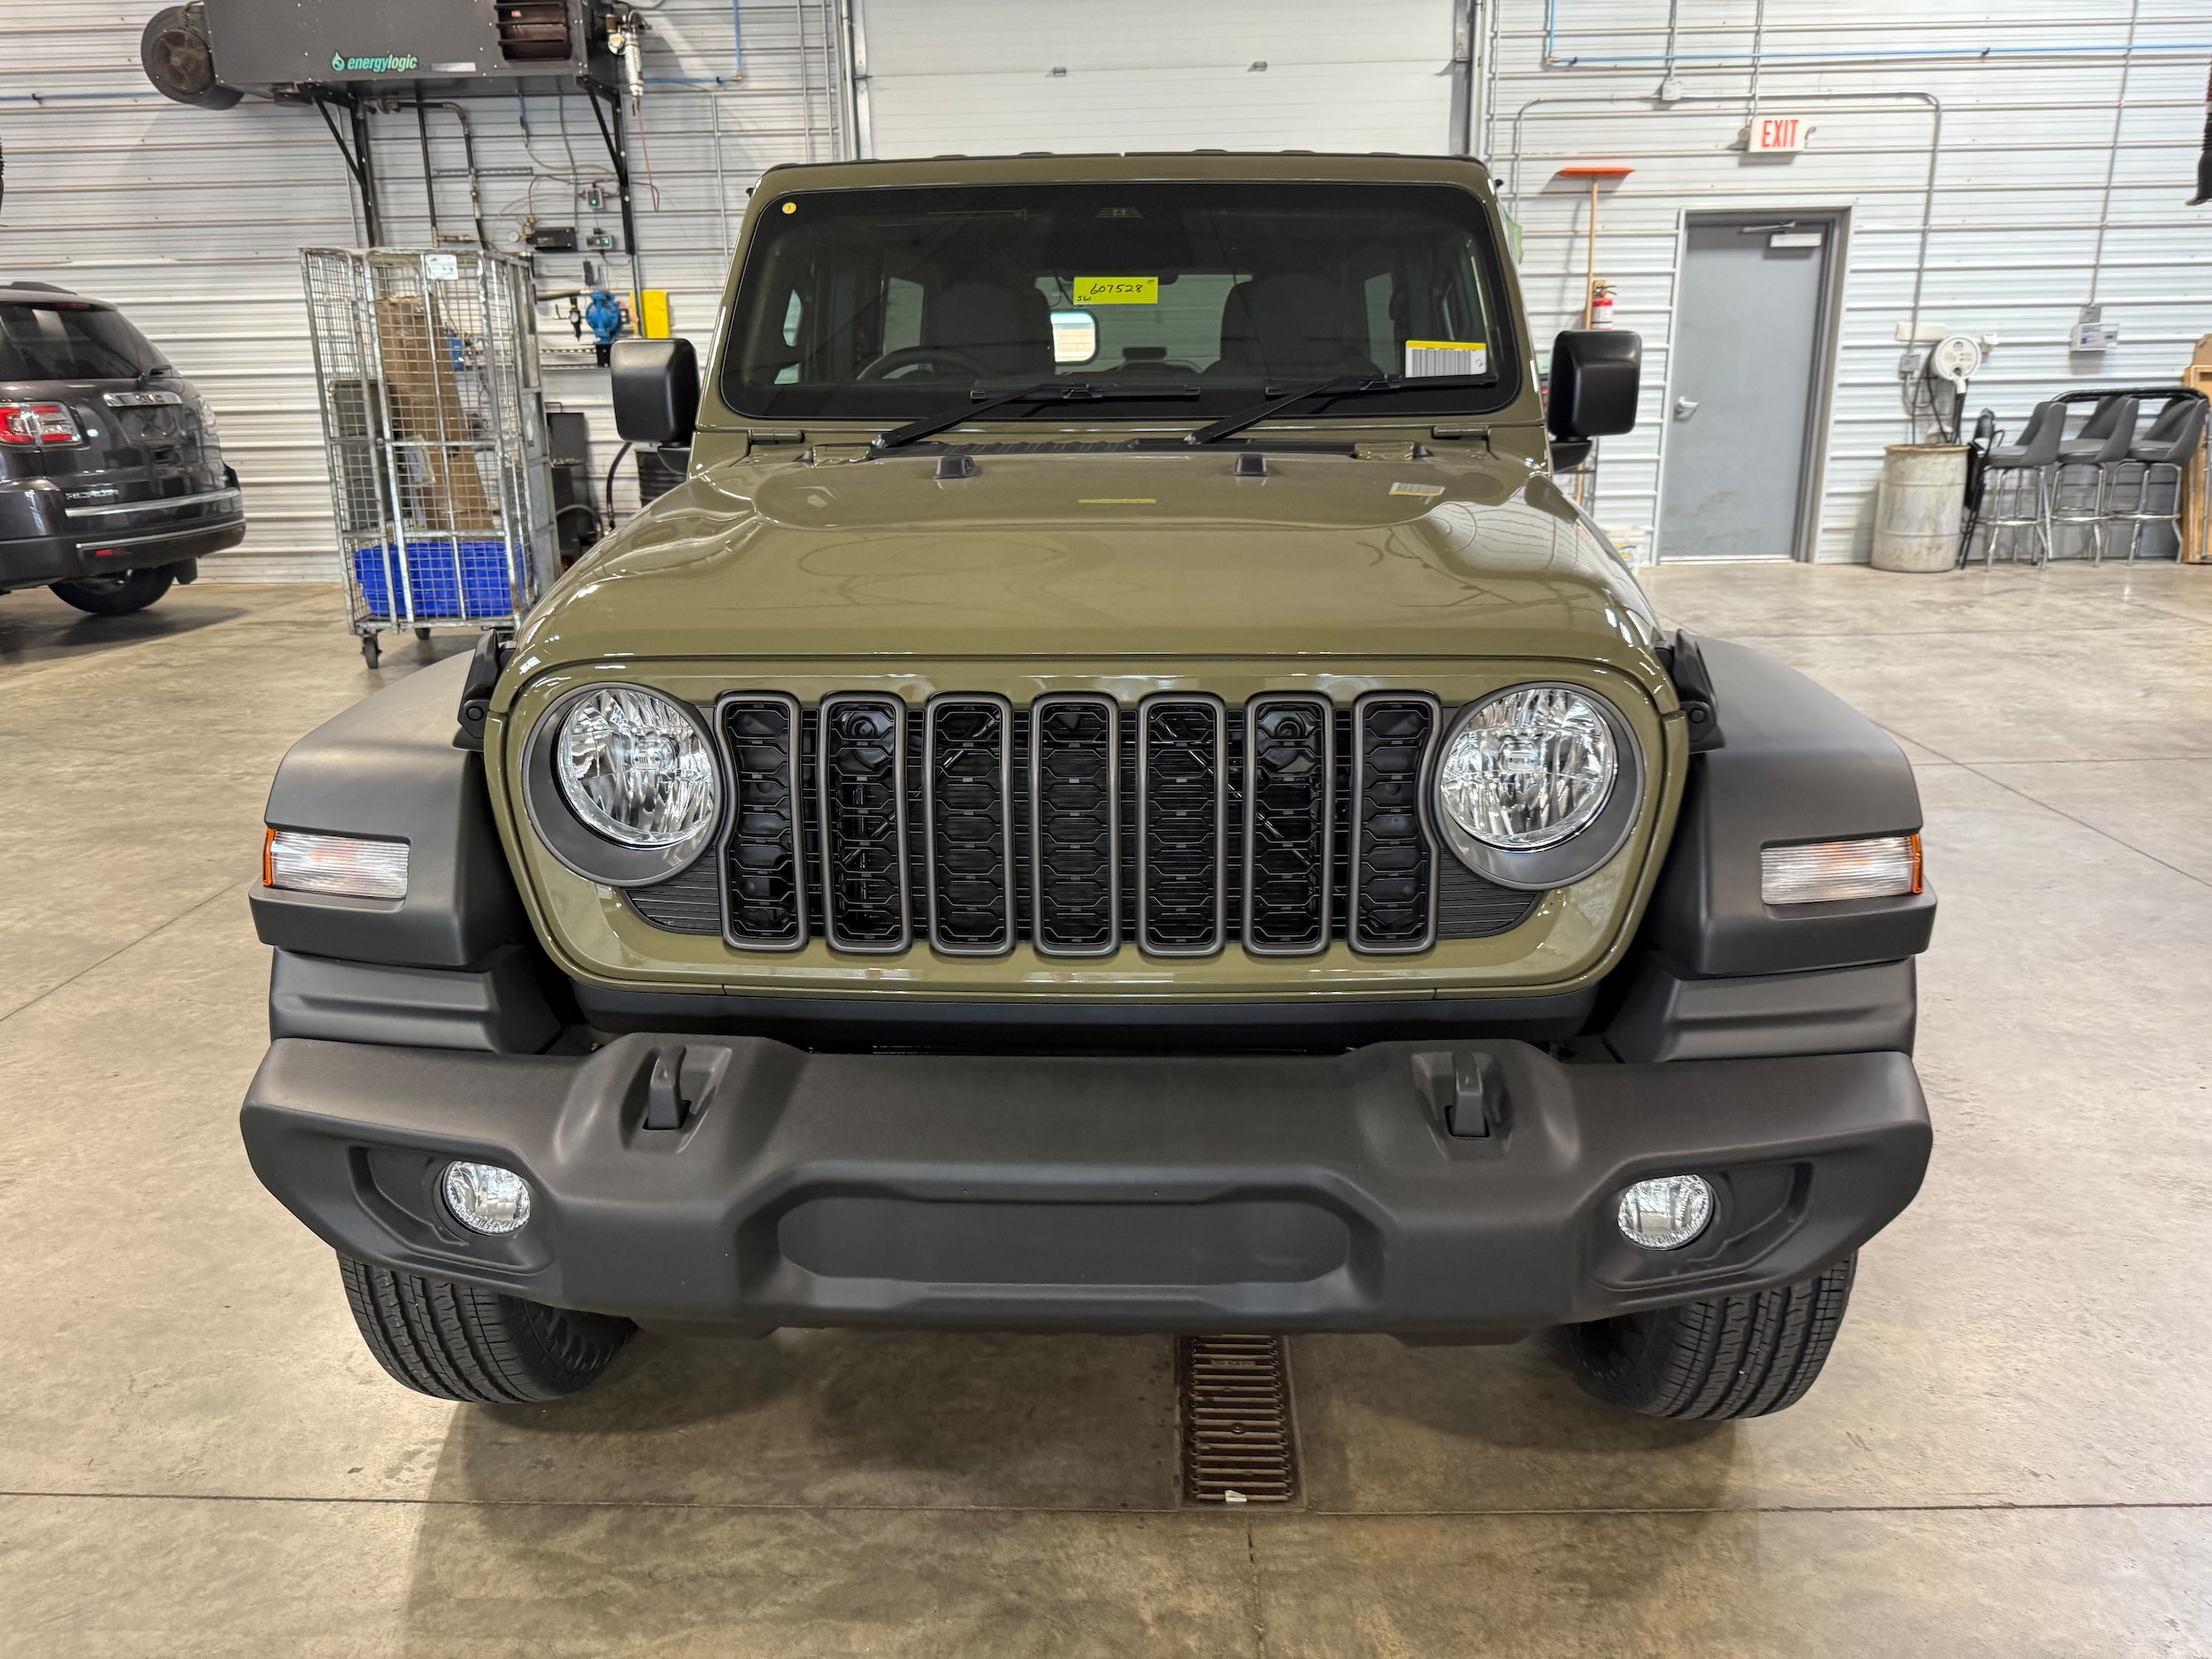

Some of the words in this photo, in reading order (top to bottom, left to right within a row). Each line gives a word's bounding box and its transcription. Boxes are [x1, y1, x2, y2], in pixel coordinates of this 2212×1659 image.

[347, 53, 419, 73] energylogic
[1762, 119, 1799, 148] EXIT
[1090, 283, 1143, 295] 607528
